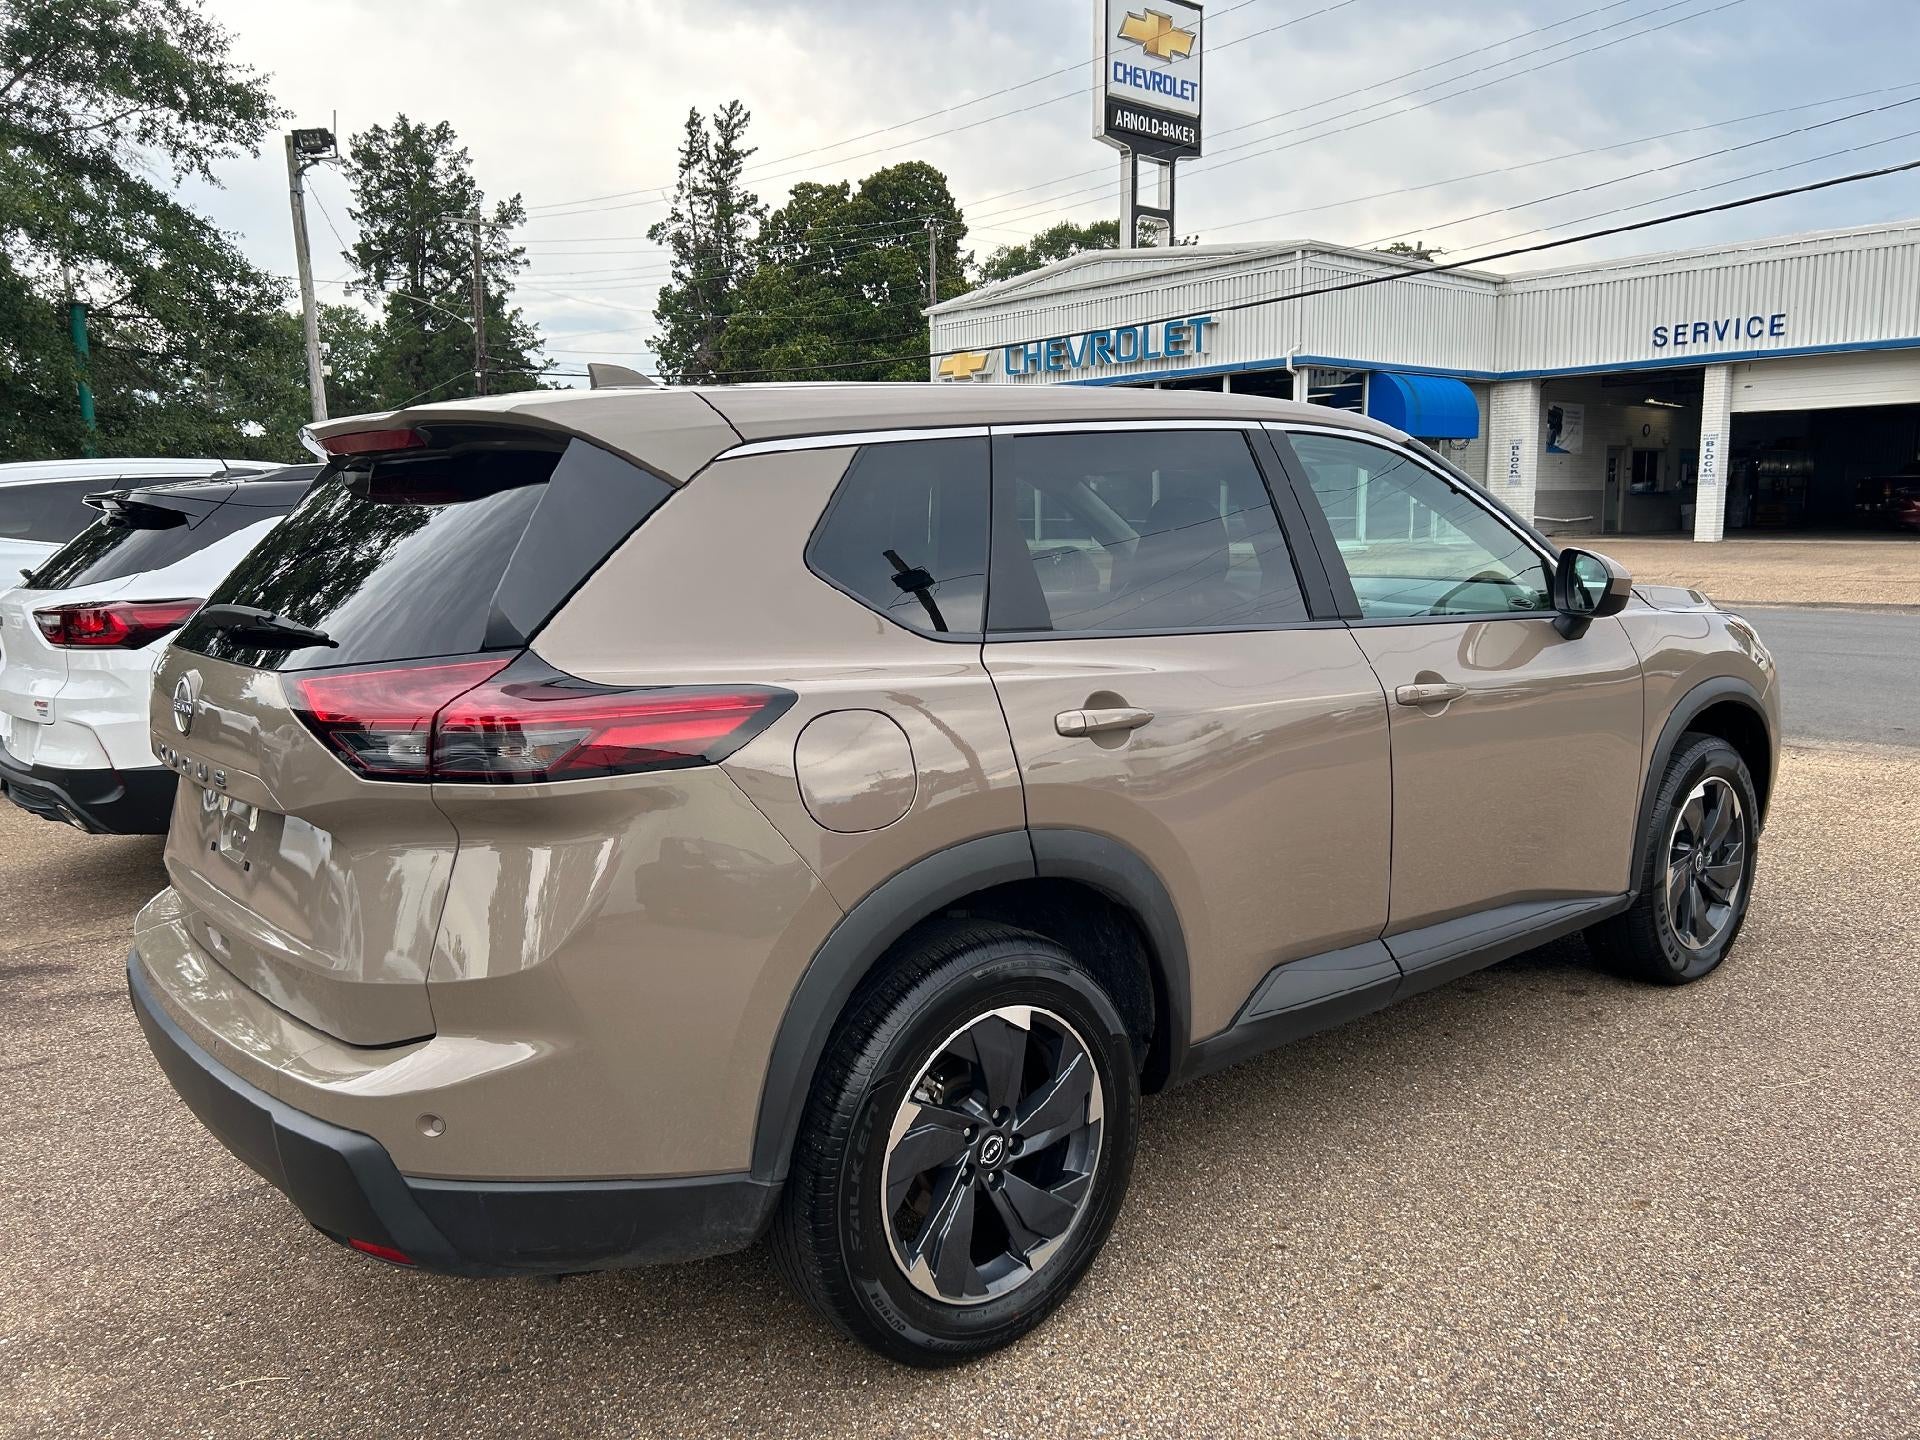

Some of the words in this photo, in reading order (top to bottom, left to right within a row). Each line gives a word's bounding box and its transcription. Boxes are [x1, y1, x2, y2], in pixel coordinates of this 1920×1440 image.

[1113, 61, 1198, 102] CHEVROLET
[1115, 109, 1195, 144] ARNOLD-BAKER
[1004, 316, 1213, 376] CHEVROLET
[1652, 313, 1786, 347] SERVICE
[1510, 445, 1519, 474] BLOCK
[1703, 440, 1714, 473] BLOCK
